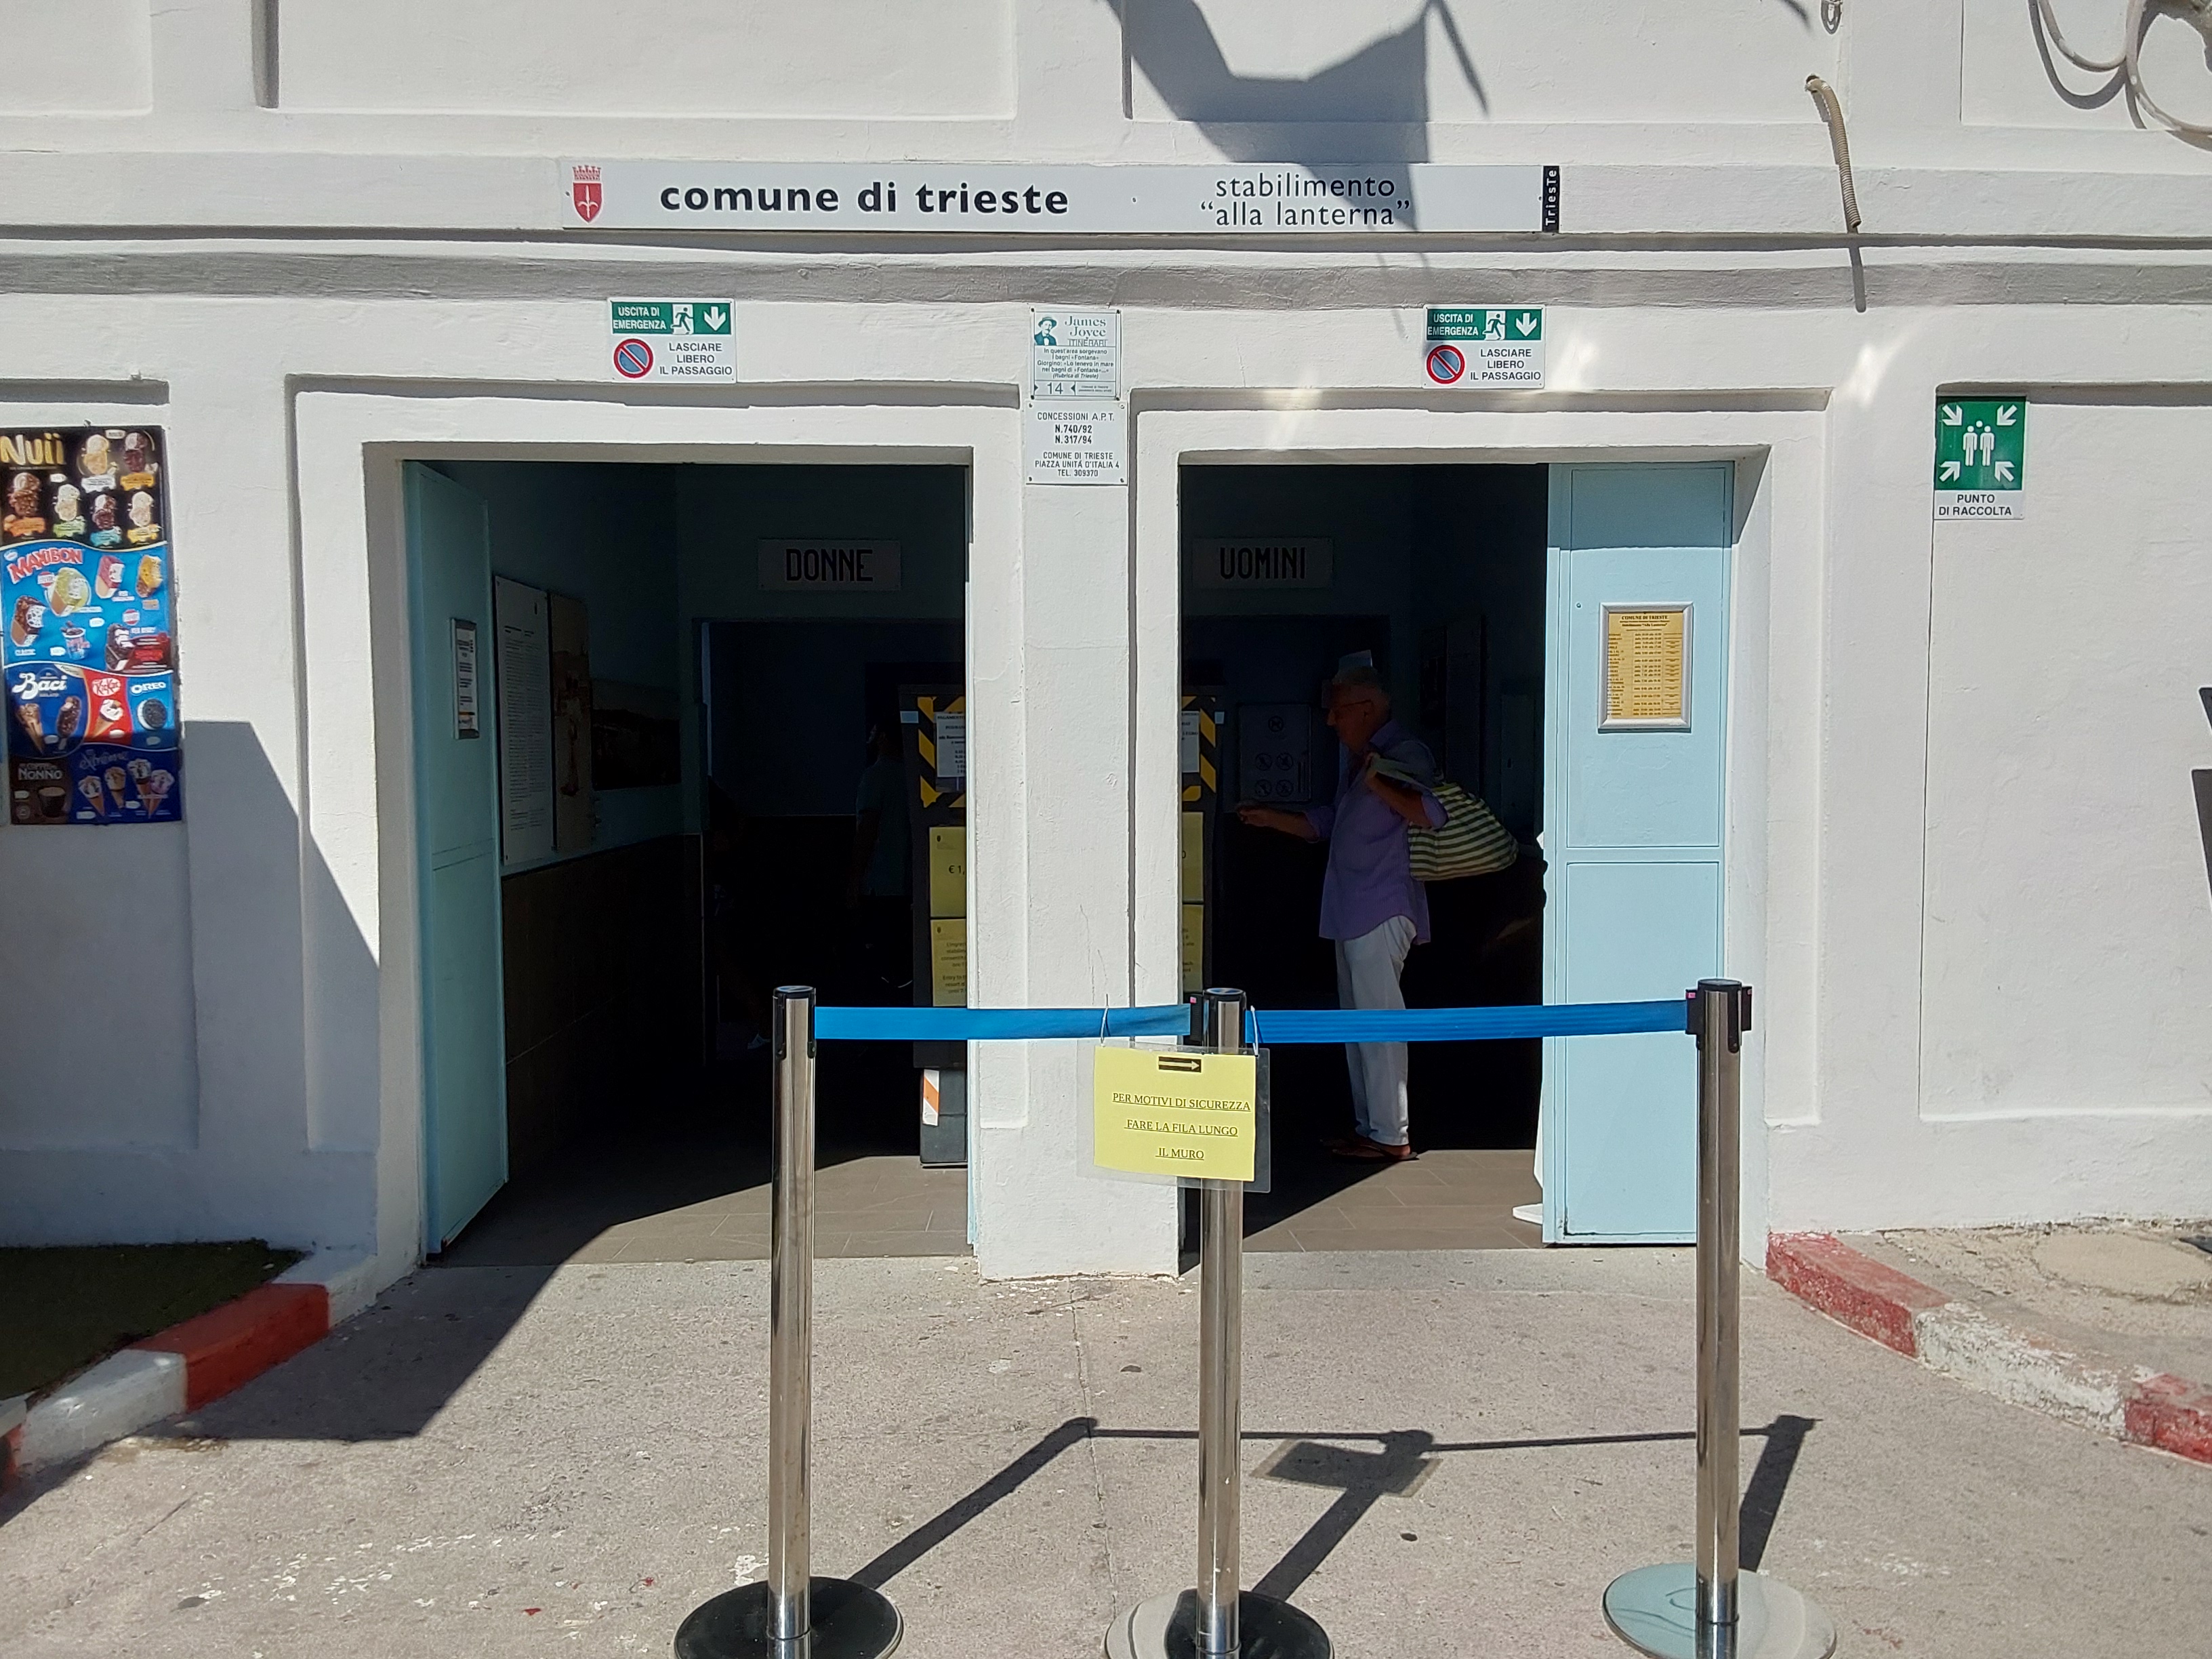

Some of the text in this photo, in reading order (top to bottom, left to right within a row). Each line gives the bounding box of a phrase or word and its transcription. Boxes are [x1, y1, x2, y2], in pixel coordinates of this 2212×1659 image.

[1216, 172, 1395, 197] stabilimento
[660, 182, 1069, 214] comune di trieste
[618, 307, 660, 316] USCITA DI
[1065, 316, 1106, 327] James
[1433, 314, 1473, 323] USCITA DI
[613, 319, 667, 329] EMERGENZA
[1069, 327, 1106, 337] Joyce
[1427, 326, 1479, 335] EMERGENZA
[669, 342, 722, 352] LASCIARE
[1481, 348, 1532, 357] LASCIARE
[677, 354, 715, 363] LIBERO
[1488, 361, 1524, 369] LIBERO
[659, 366, 733, 375] IL PASSAGGIO
[1471, 372, 1541, 380] IL PASSAGGIO
[1047, 382, 1063, 394] 14
[1038, 412, 1088, 420] CONCESSIONI
[1054, 424, 1092, 434] N.740/92
[1054, 435, 1092, 444] N.317/94
[1043, 451, 1072, 459] COMUNE
[1074, 469, 1099, 477] 309370
[1957, 494, 1995, 504] PUNTO
[1939, 506, 2012, 516] DI RACCOLTA
[7, 548, 83, 584] MAXIBON
[785, 550, 873, 581] DONNE
[1220, 547, 1306, 579] UOMINI
[12, 672, 67, 699] Baci
[130, 681, 167, 695] OREO
[18, 768, 63, 780] NONNO
[949, 865, 955, 874] €
[1113, 1092, 1250, 1111] PER MOTIVI DI SICUREZZA
[1127, 1120, 1237, 1136] FARE LA FILA LUNGO
[1158, 1147, 1204, 1159] IL MURO
